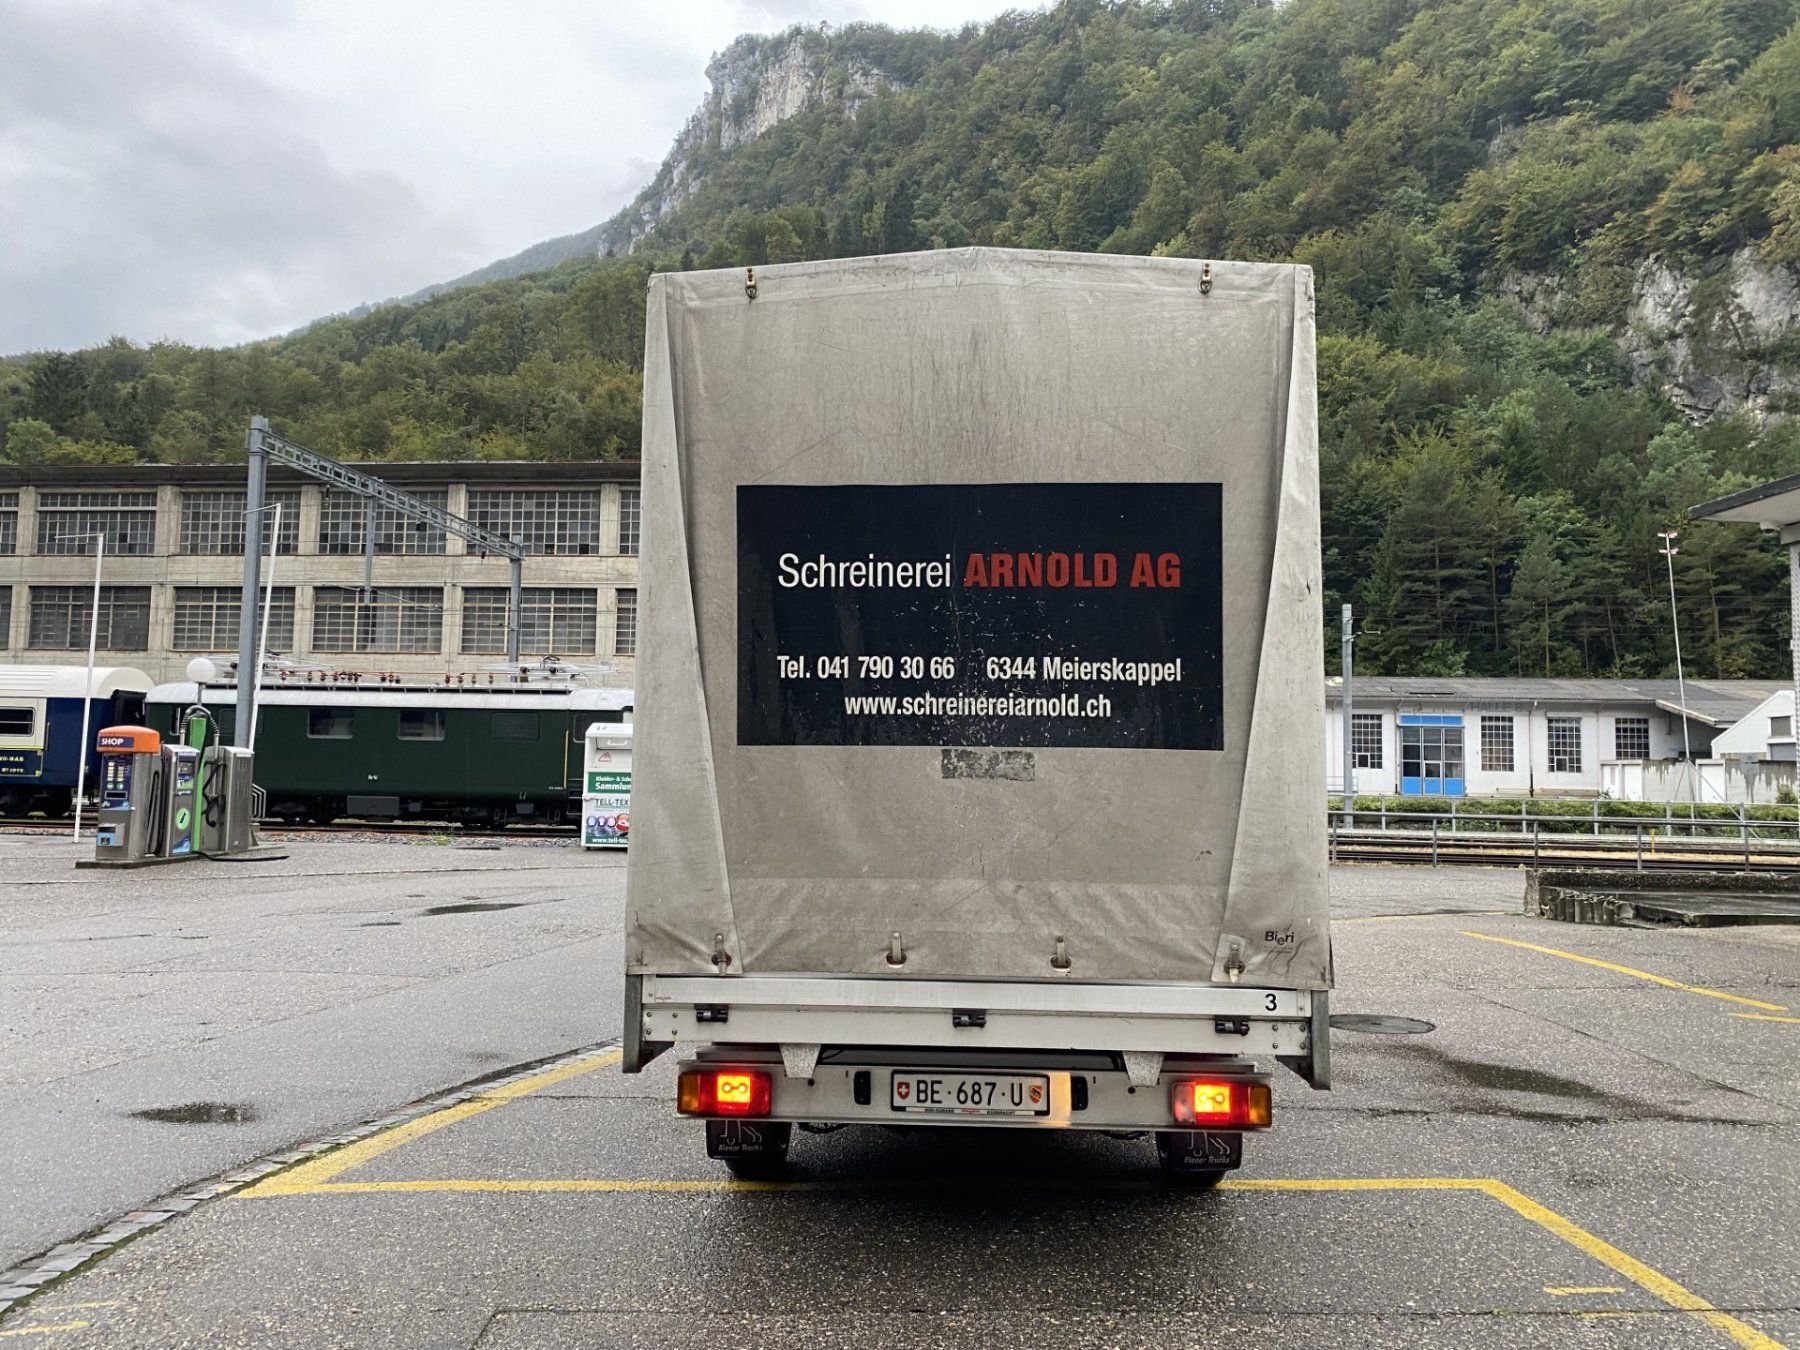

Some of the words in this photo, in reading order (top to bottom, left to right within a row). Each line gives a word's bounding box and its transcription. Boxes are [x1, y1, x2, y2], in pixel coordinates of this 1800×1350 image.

[779, 553, 951, 588] Schreinerei
[963, 553, 1117, 587] ARNOLD
[1130, 552, 1181, 587] AG
[777, 655, 811, 679] Tel.
[817, 655, 849, 679] 041
[858, 655, 894, 679] 790
[900, 656, 924, 680] 30
[930, 656, 955, 680] 66
[986, 656, 1036, 681] 6344
[1043, 656, 1182, 686] Meierskappel
[845, 693, 1111, 717] www.schreinereiarnold.ch
[101, 737, 124, 746] SHOP
[595, 798, 629, 806] TELL-TEX
[1264, 930, 1295, 946] Bieri
[1264, 993, 1278, 1012] 3
